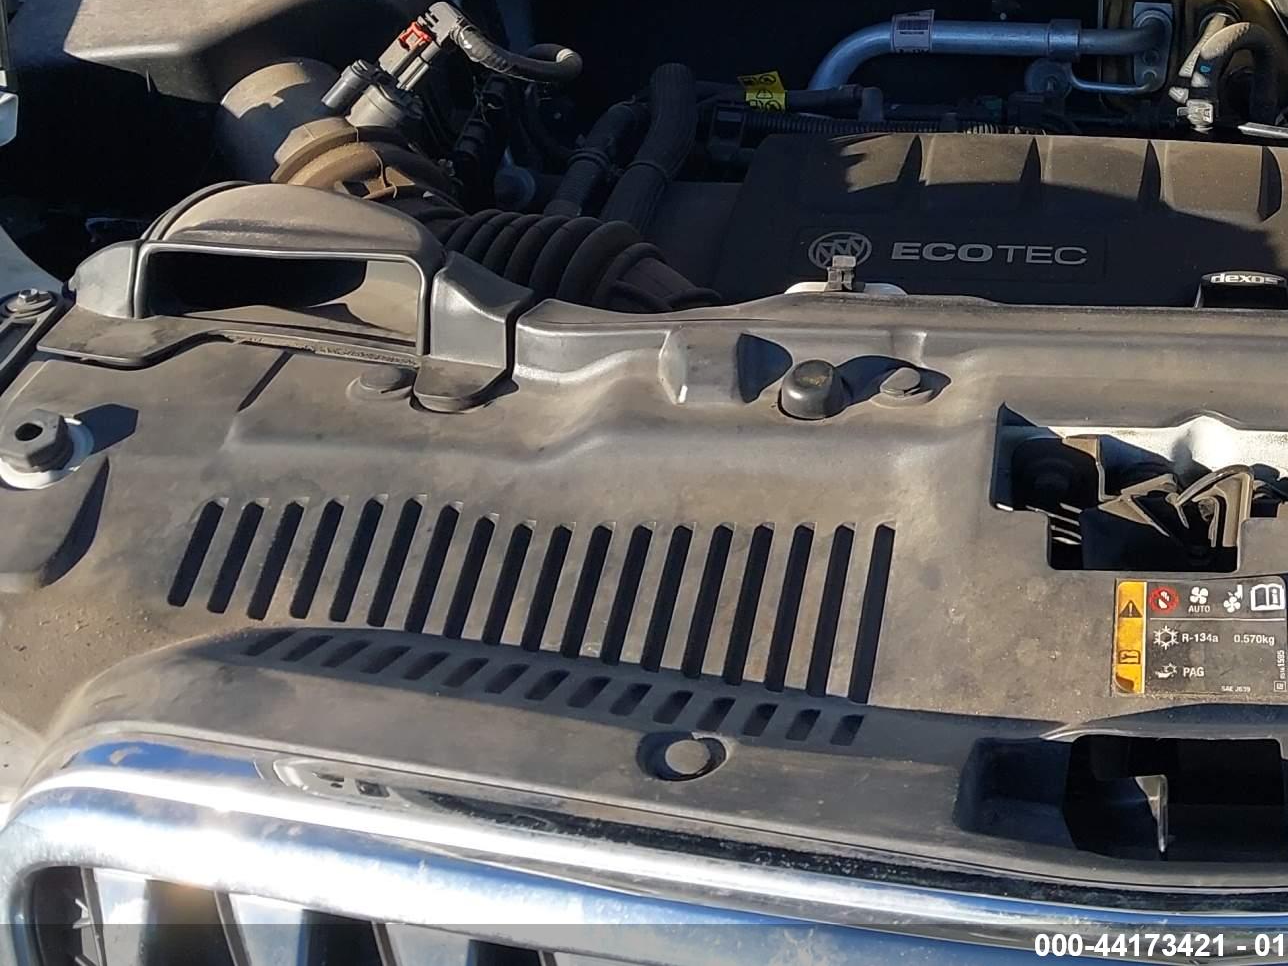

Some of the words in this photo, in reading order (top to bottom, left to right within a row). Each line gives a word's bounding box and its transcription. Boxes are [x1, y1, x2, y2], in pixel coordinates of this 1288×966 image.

[891, 242, 1088, 265] ECOTEC
[1210, 273, 1278, 285] dexos
[1188, 605, 1210, 613] AUTO
[1181, 633, 1219, 643] R-134a
[1233, 634, 1275, 646] 0.570kg
[1183, 666, 1205, 678] PAG
